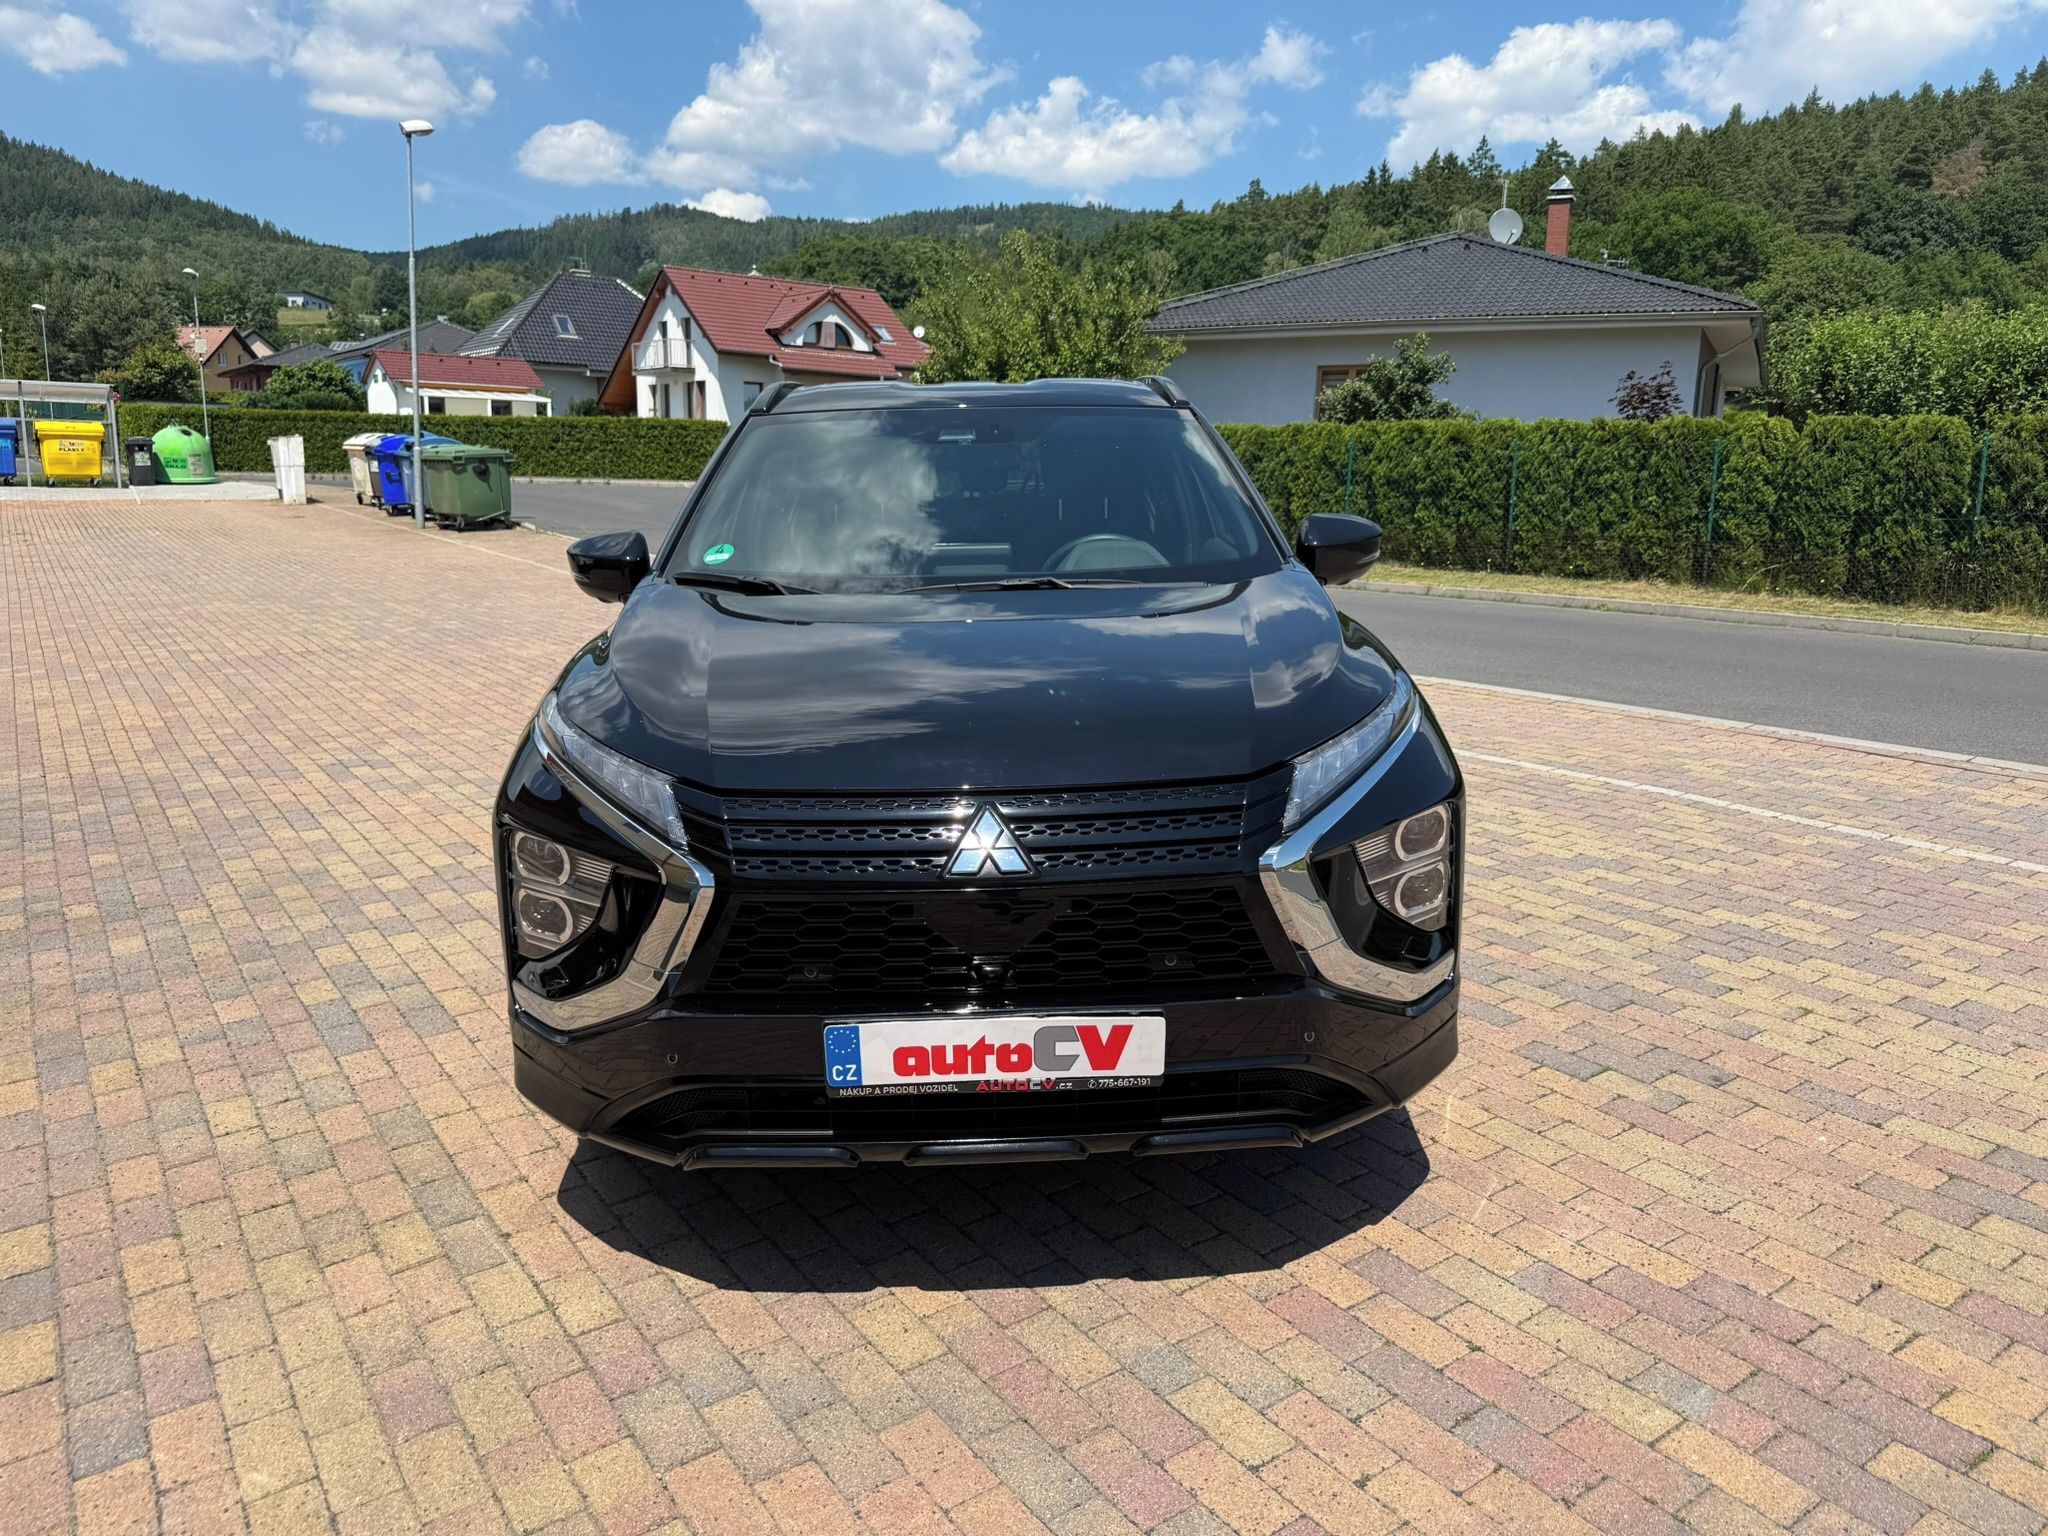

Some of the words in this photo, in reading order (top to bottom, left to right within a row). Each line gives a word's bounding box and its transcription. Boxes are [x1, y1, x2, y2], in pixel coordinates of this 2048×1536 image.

[893, 1025, 1133, 1076] autoCV
[832, 1065, 857, 1081] CZ
[873, 1086, 881, 1095] A
[883, 1085, 917, 1095] PRODEJ
[919, 1083, 958, 1093] VOZIDEL
